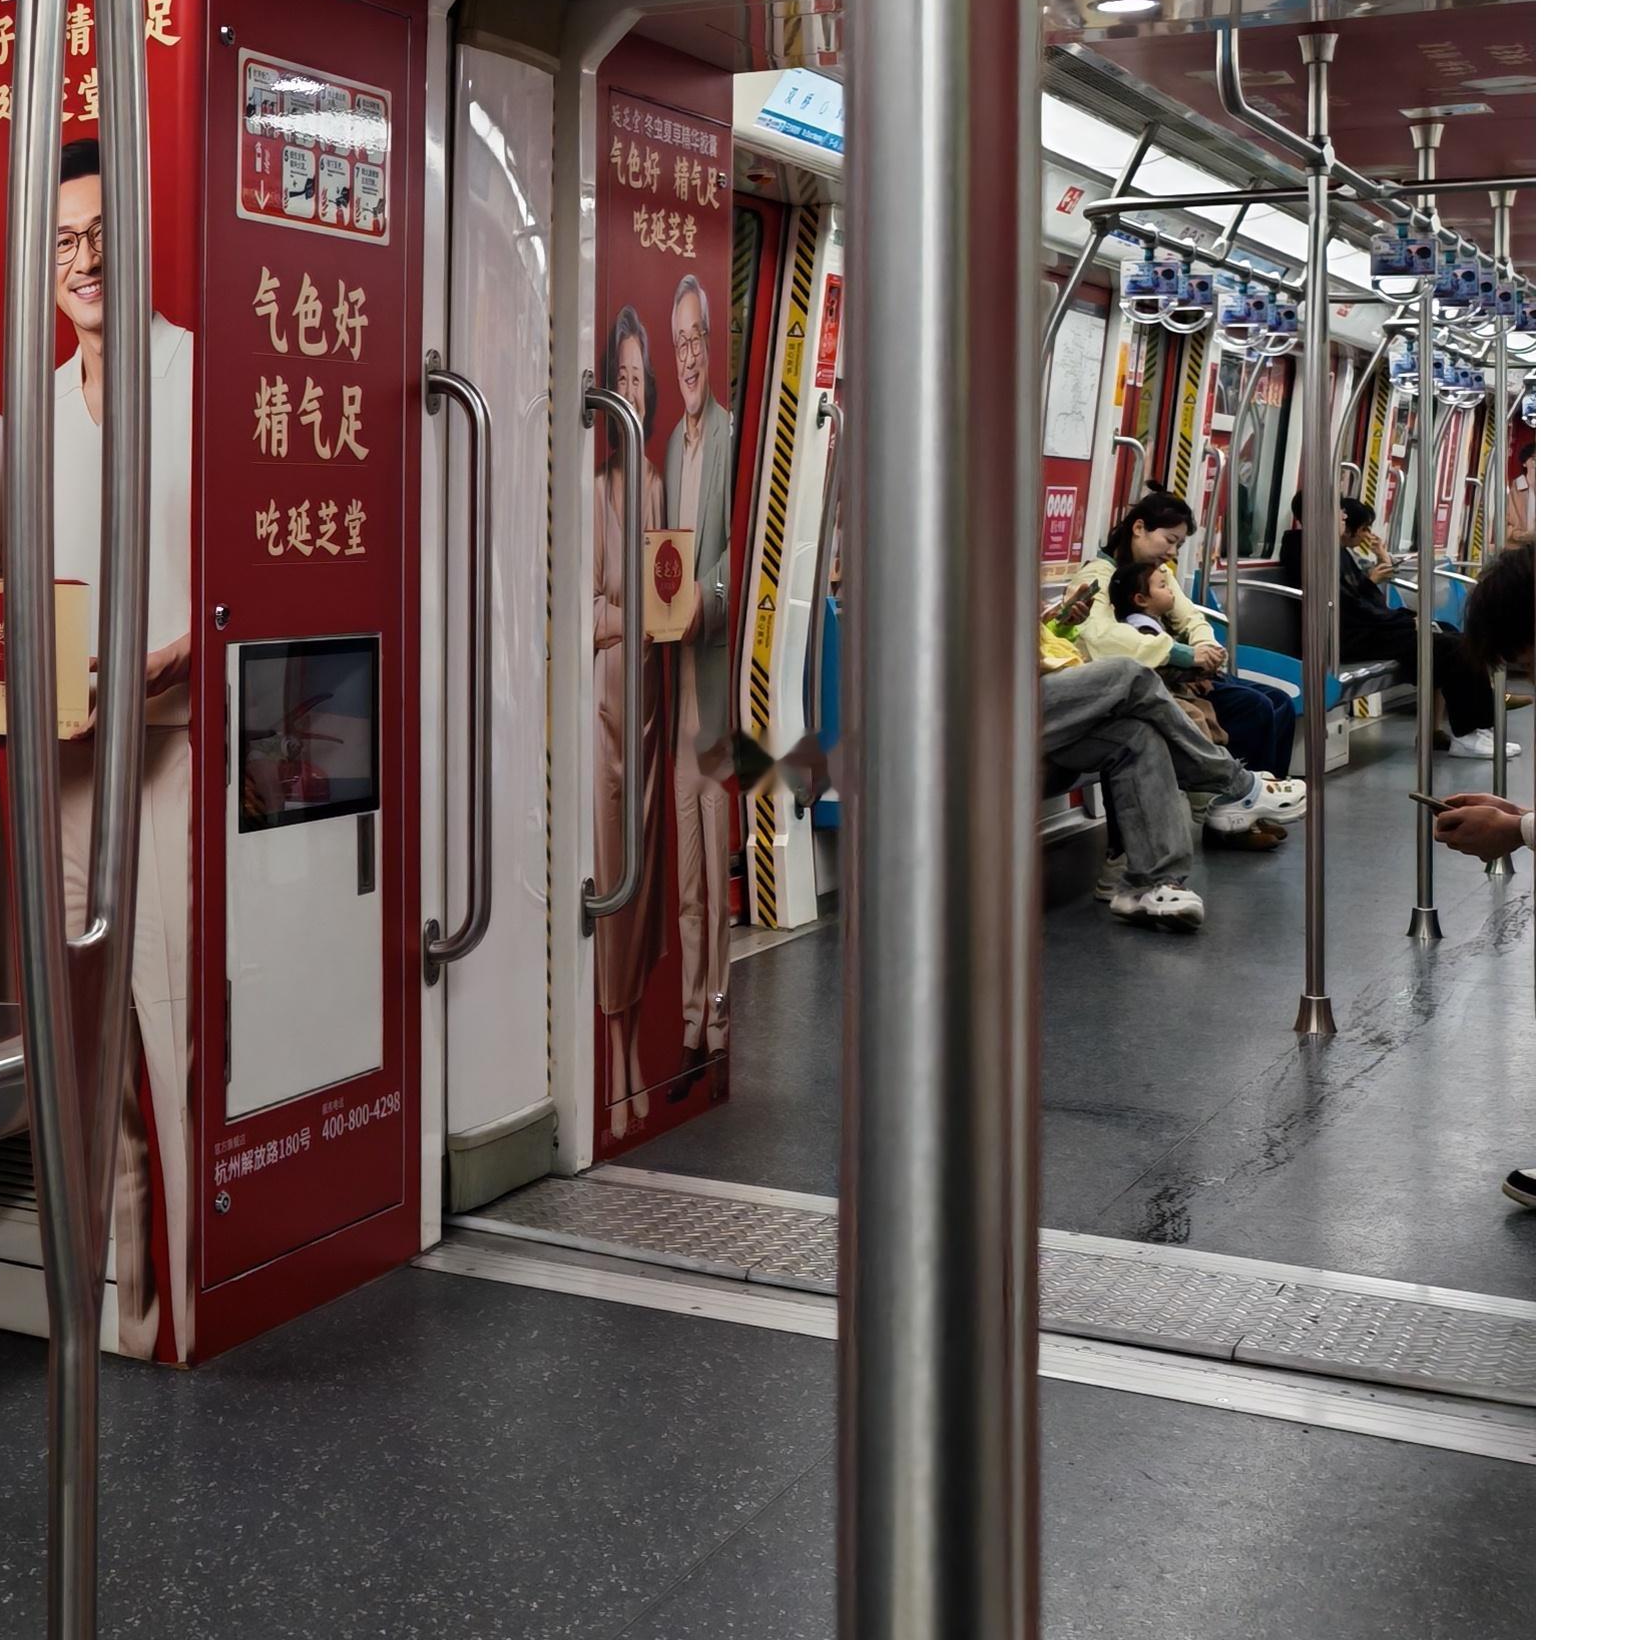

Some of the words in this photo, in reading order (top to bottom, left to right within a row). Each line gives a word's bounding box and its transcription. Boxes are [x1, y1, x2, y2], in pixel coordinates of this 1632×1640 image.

[610, 135, 661, 194] 气色好
[673, 155, 720, 210] 精气足
[633, 204, 698, 259] 吃延芝堂
[252, 266, 369, 361] 气色好
[253, 375, 370, 461] 精气足
[255, 498, 368, 557] 吃延芝堂
[322, 1091, 401, 1141] 400-800-4298
[214, 1127, 312, 1187] 杭州解放路180号
